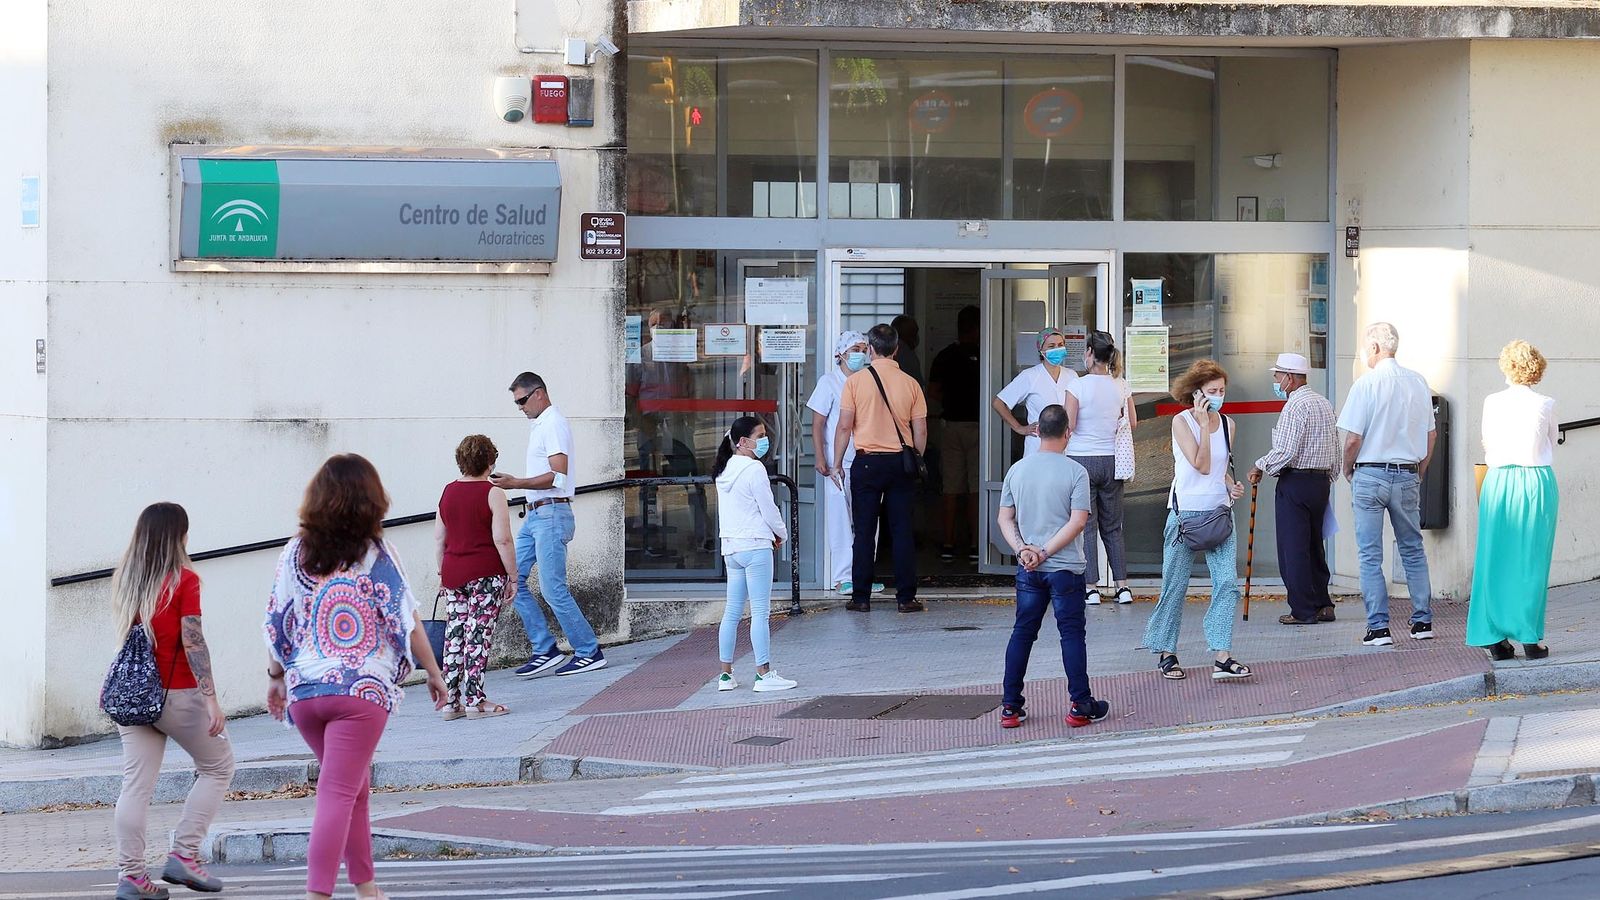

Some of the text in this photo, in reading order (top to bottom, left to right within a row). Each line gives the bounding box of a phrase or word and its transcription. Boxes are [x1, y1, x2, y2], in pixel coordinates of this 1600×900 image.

[399, 203, 546, 226] Centro de Salud
[209, 234, 227, 242] JUNTA
[229, 234, 236, 242] DE
[478, 230, 545, 246] Adoratrices
